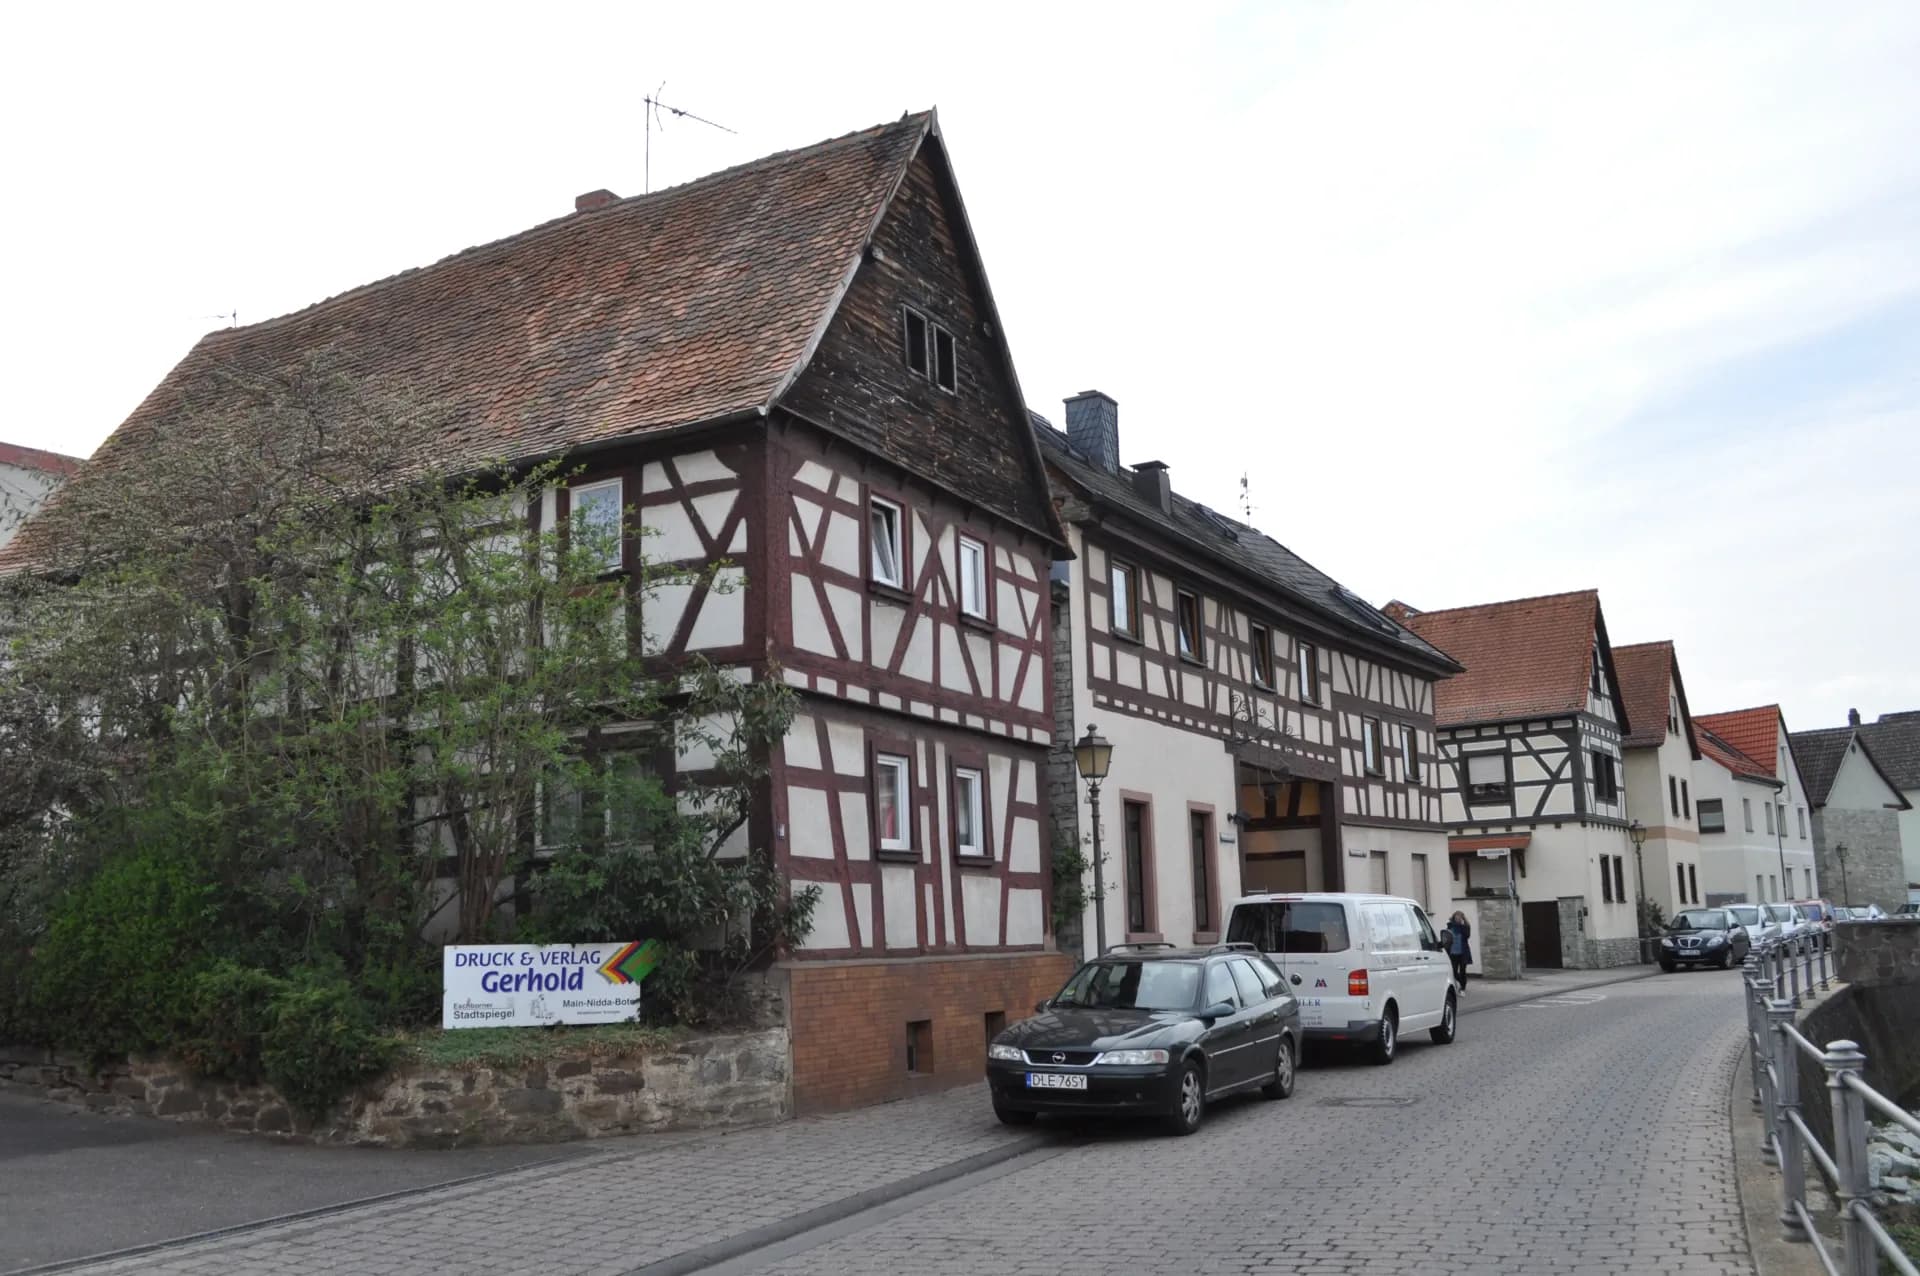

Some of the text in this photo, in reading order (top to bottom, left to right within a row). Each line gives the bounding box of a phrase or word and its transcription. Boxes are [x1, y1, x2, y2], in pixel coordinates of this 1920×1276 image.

[455, 950, 601, 967] DRUCK & VERLAG
[481, 966, 584, 993] Gerhold
[453, 1009, 515, 1021] Stadtspiegel
[1032, 1074, 1056, 1087] DLE
